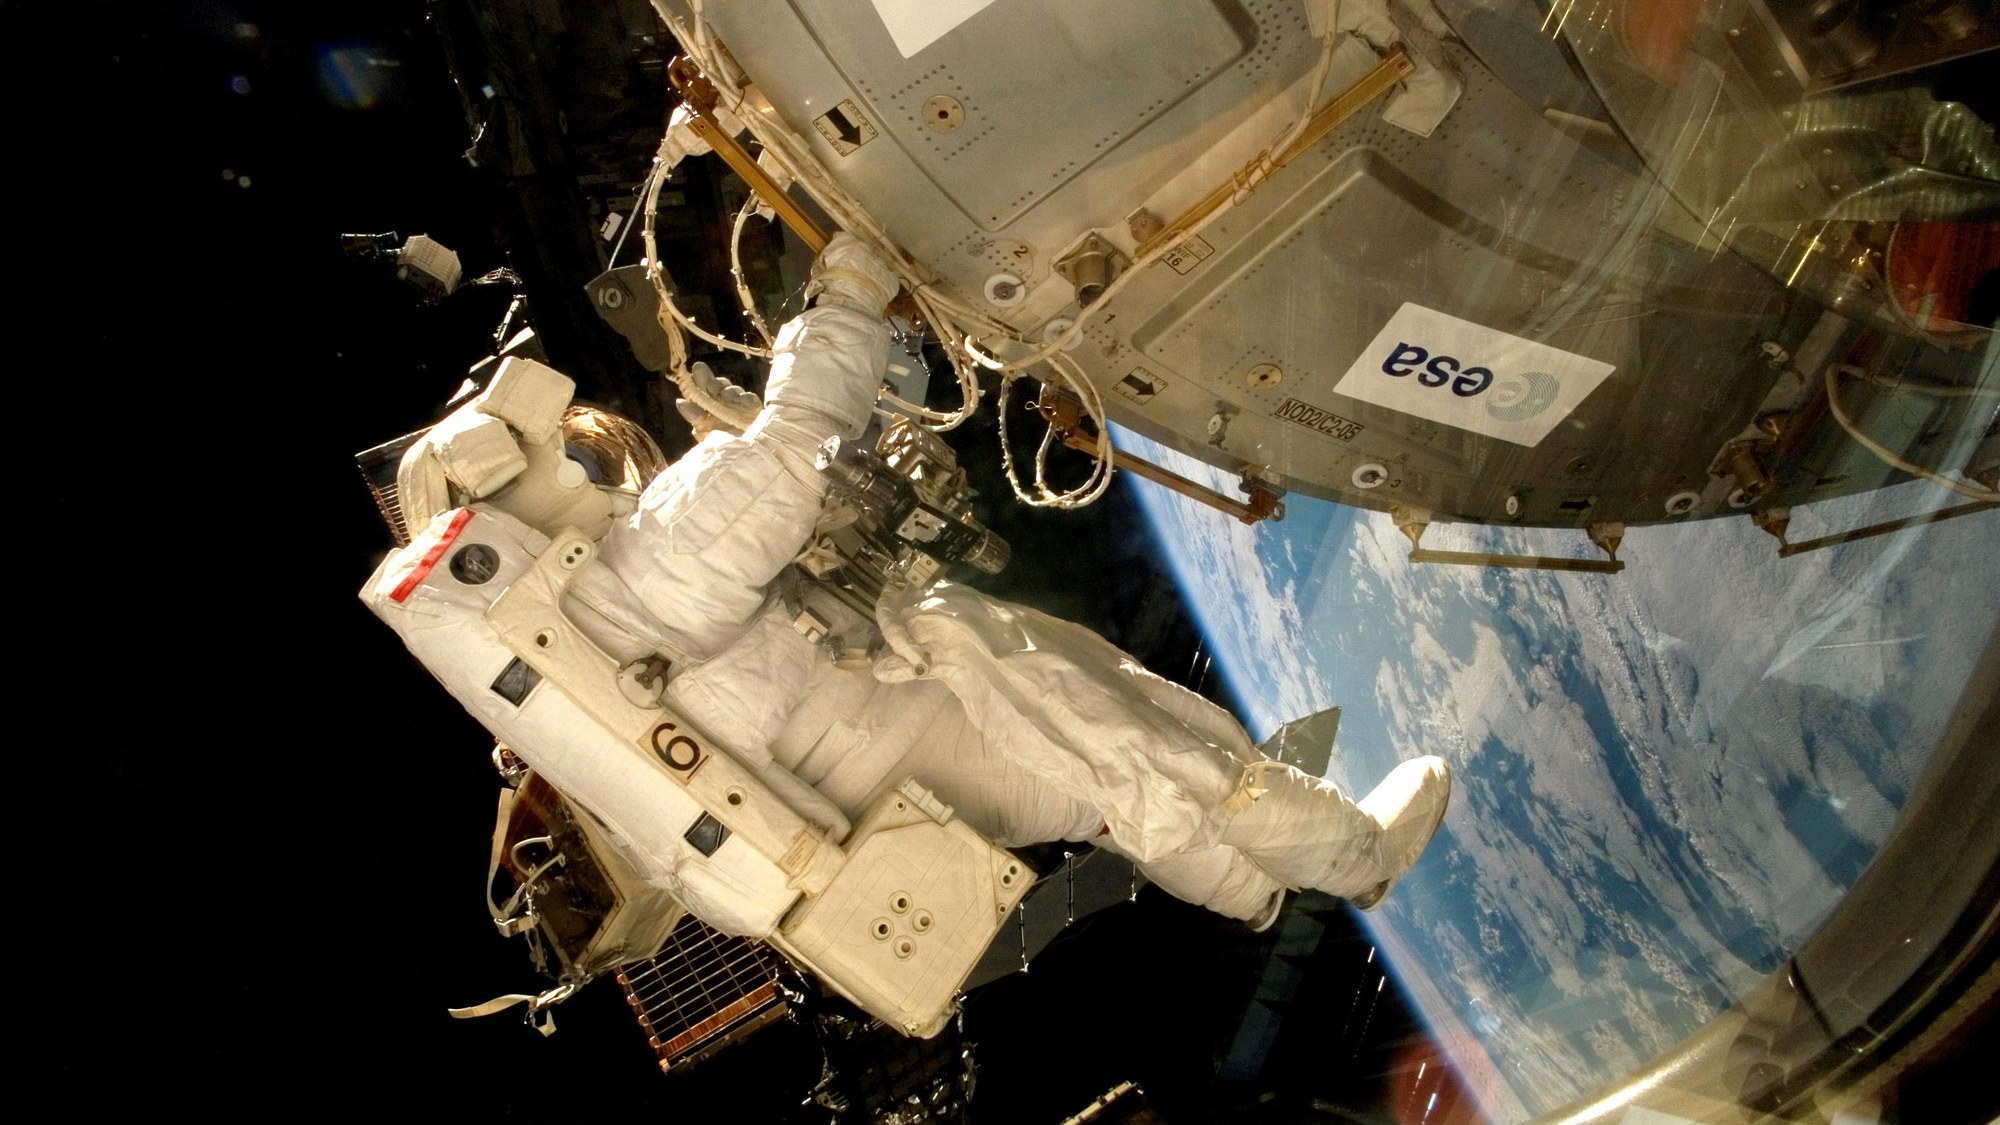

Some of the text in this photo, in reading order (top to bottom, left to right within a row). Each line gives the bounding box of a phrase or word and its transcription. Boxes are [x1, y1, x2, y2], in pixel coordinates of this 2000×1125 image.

[1013, 245, 1029, 259] 2
[1167, 253, 1183, 266] 16
[1104, 313, 1116, 324] 1
[1382, 342, 1493, 397] esa
[1280, 400, 1361, 440] NOD2/C2-05
[1390, 479, 1402, 488] 3
[914, 519, 929, 530] 1
[650, 722, 701, 772] 6
